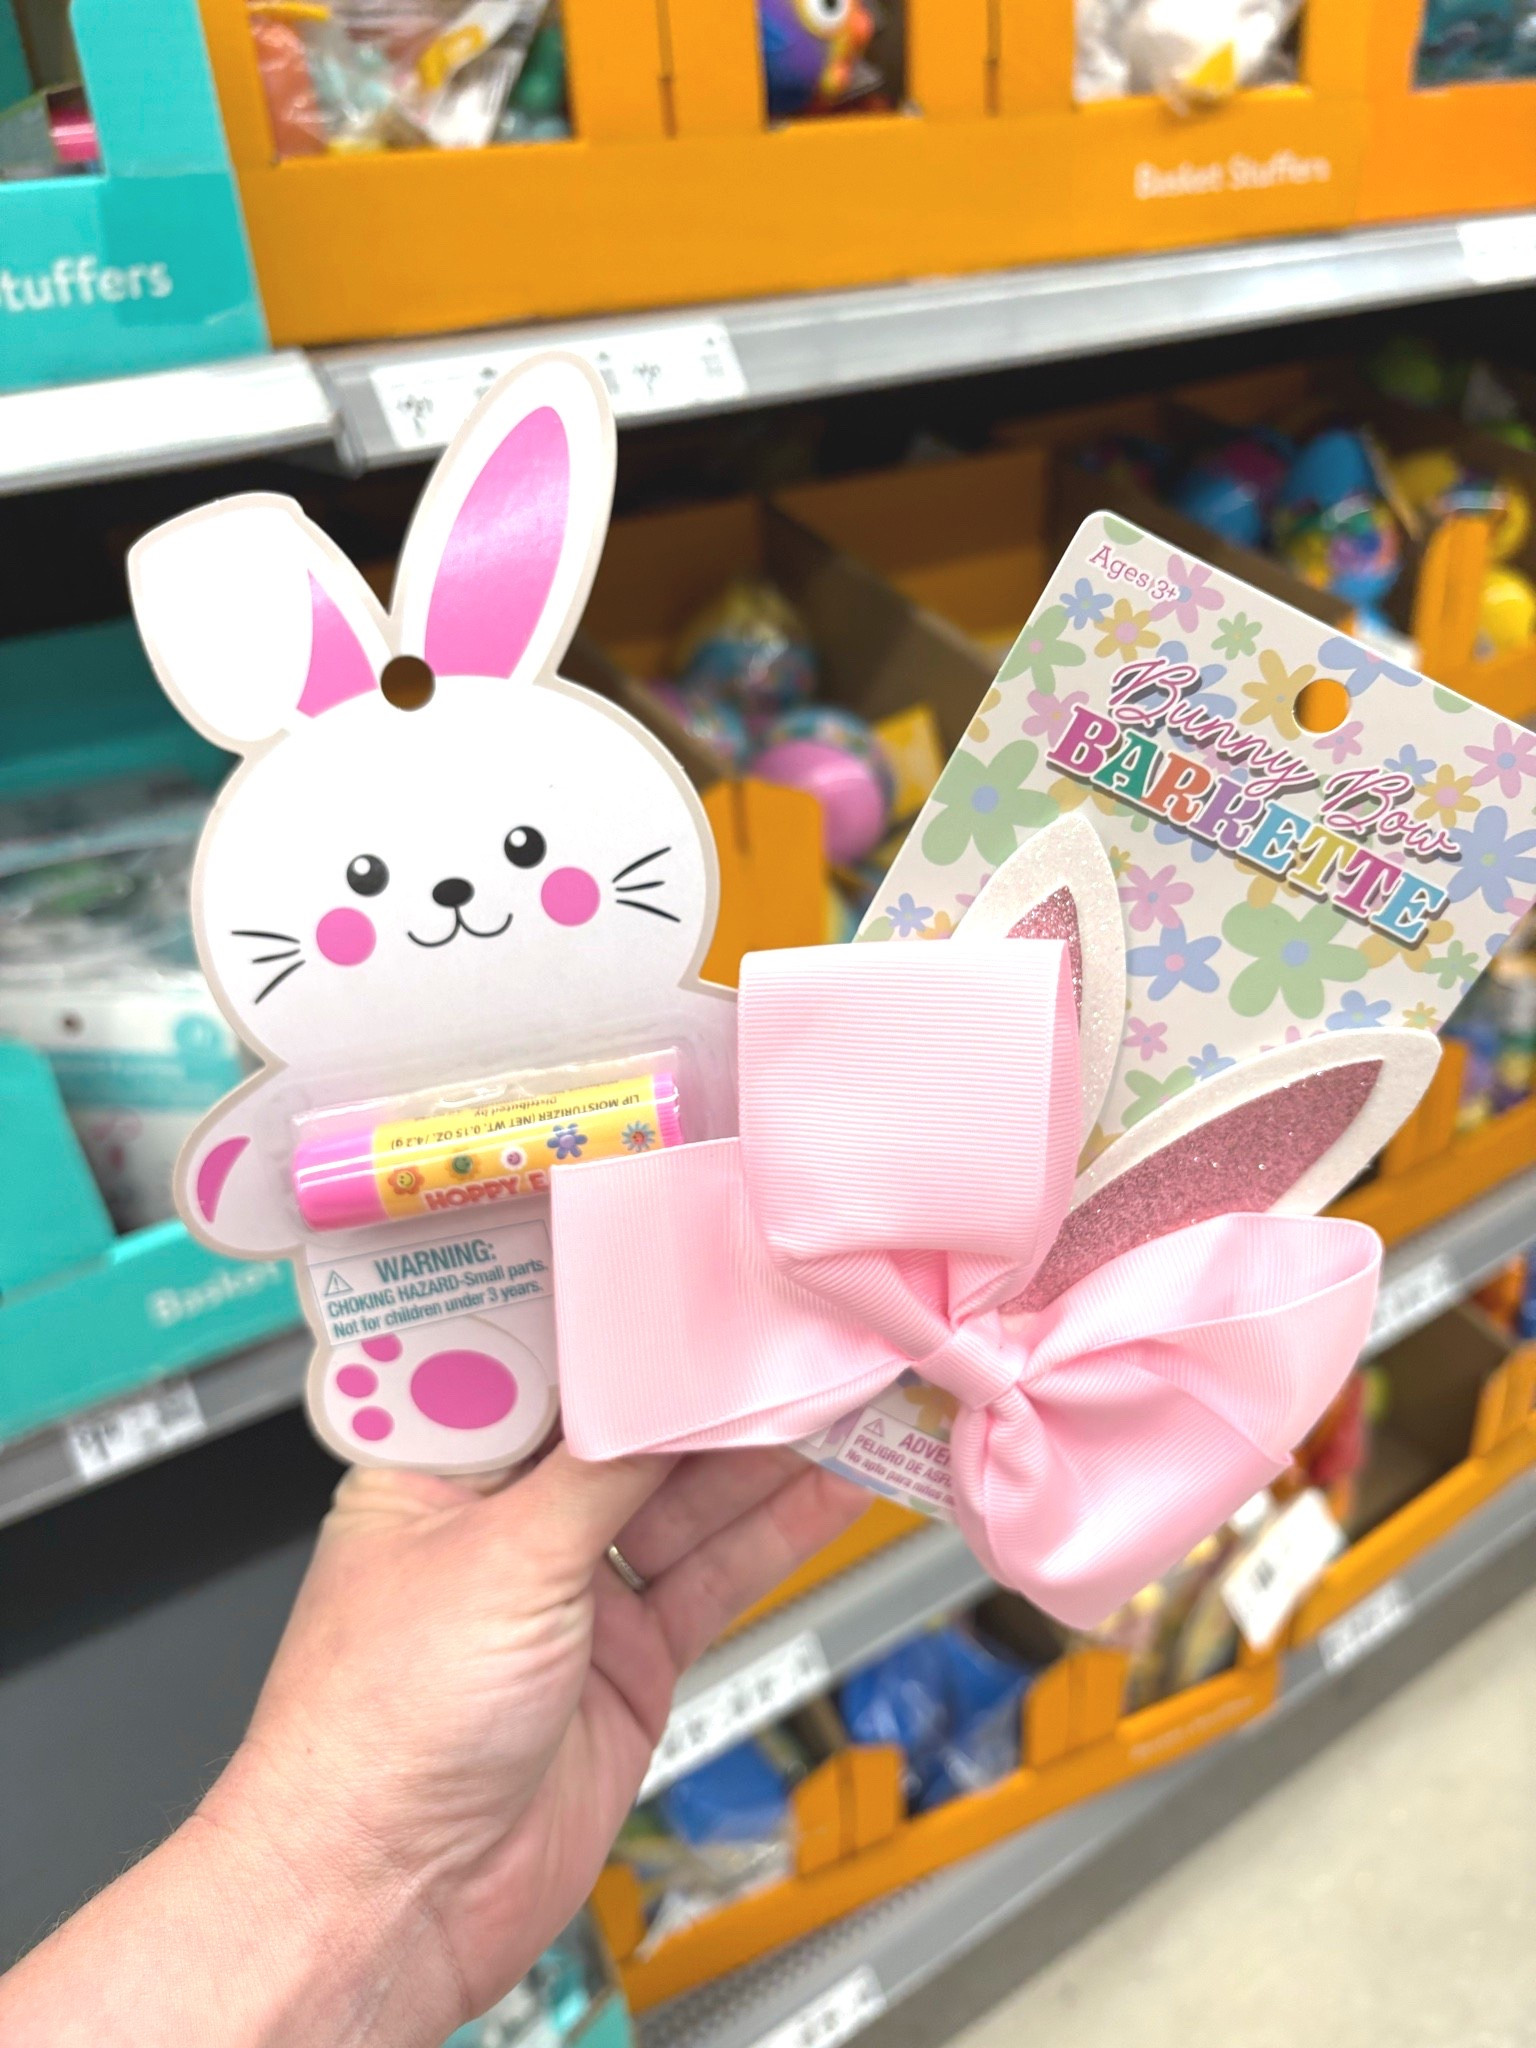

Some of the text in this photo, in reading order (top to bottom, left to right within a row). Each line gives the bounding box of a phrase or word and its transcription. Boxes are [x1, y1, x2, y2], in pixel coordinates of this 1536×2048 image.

[0, 252, 173, 313] tuffers
[1089, 544, 1178, 600] Ages 3+
[1110, 658, 1460, 854] Bunny Bow
[1046, 704, 1447, 943] BARRETTE
[538, 1099, 619, 1123] MOISTURIZER
[623, 1094, 640, 1106] LIP
[432, 1131, 453, 1143] OZ.
[456, 1125, 481, 1138] 0.15
[486, 1119, 508, 1132] WT.
[509, 1113, 536, 1127] (NET
[423, 1174, 520, 1211] HOPPY
[374, 1239, 497, 1284] WARNING:
[328, 1257, 549, 1318] CHOKING HAZARD-Small parts.
[333, 1278, 544, 1339] Not for children under 3 years.
[844, 1449, 861, 1464] No
[861, 1459, 886, 1476] apto
[885, 1470, 912, 1488] para
[854, 1434, 952, 1488] PELIGRO DE ASF
[898, 1432, 952, 1467] ADVE
